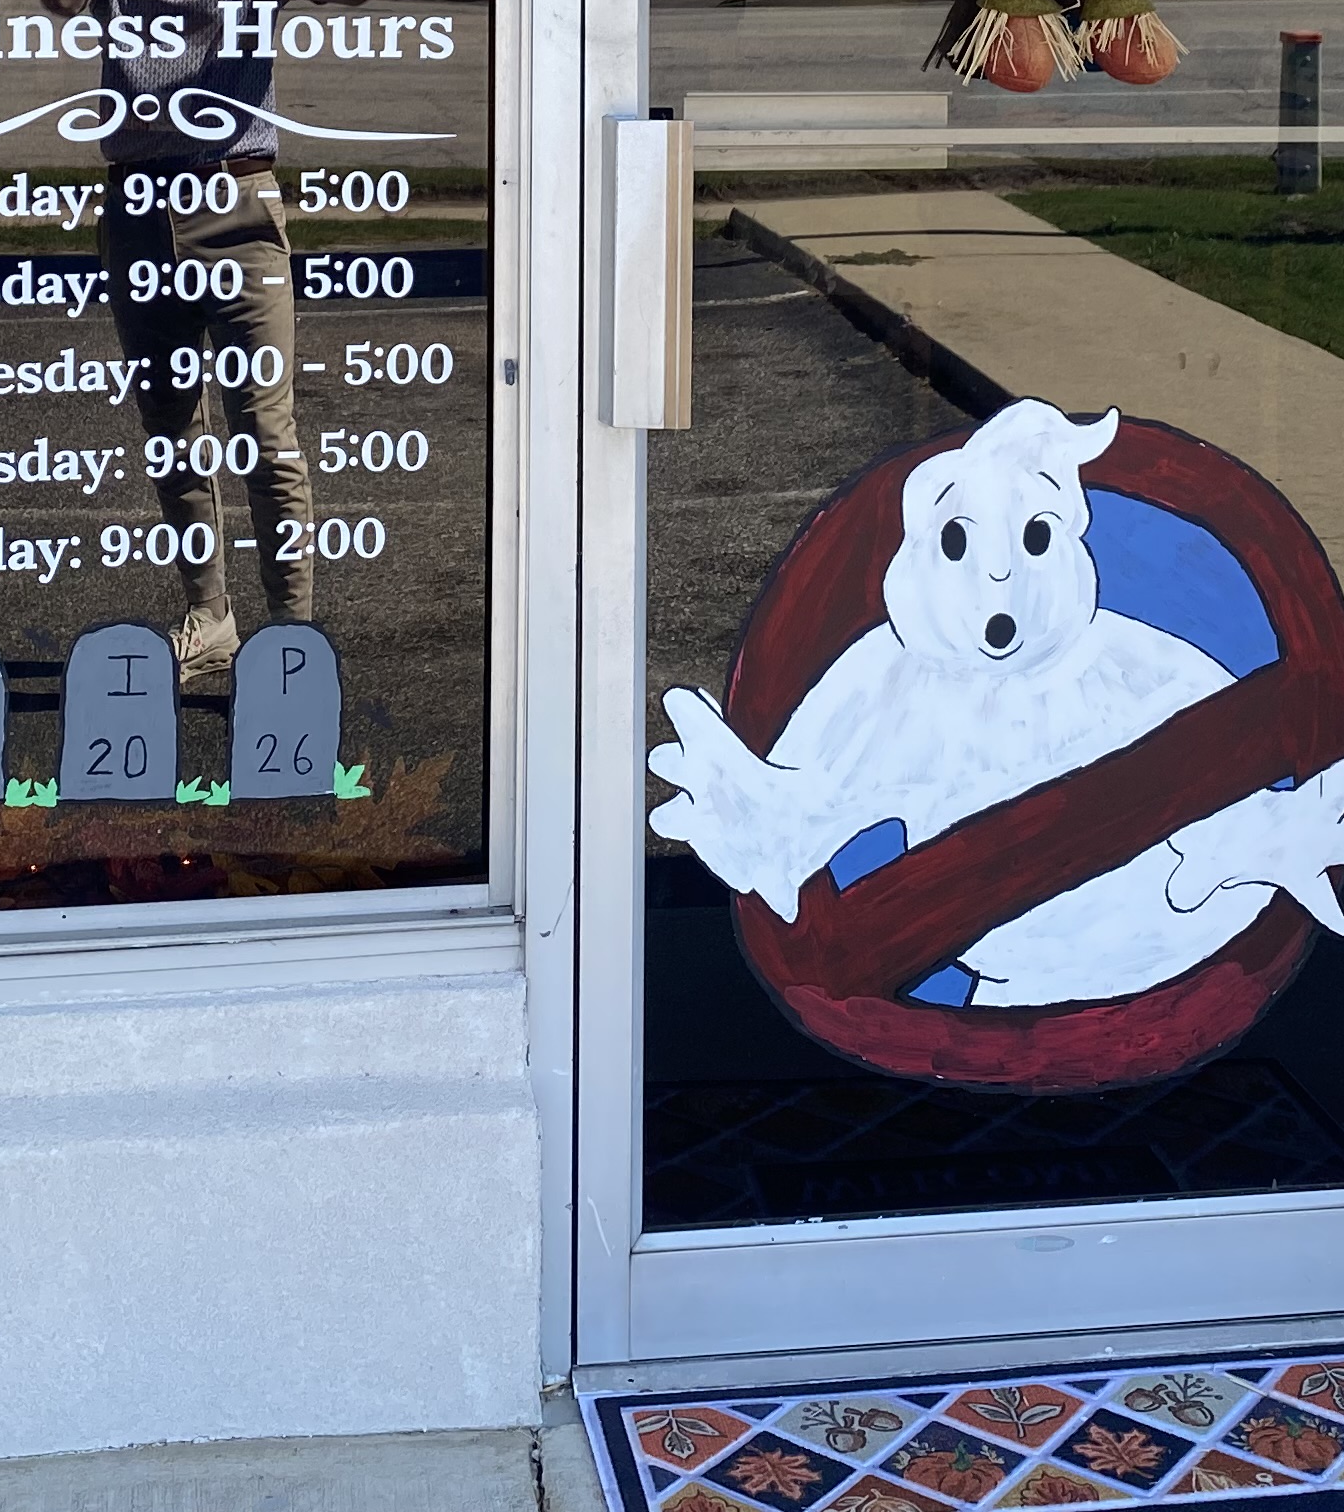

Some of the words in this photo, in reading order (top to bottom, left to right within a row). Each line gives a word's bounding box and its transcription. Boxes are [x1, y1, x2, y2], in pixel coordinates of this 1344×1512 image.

[217, 0, 454, 60] Hours
[123, 172, 239, 215] 9:00
[299, 168, 409, 213] 5:00
[128, 258, 243, 302] 9:00
[304, 254, 414, 299] 5:00
[170, 345, 284, 389] 9:00
[344, 340, 453, 386] 5:00
[144, 433, 259, 478] 9:00
[319, 428, 429, 473] 5:00
[100, 522, 215, 567] 9:00
[275, 517, 386, 561] 2:00
[107, 654, 149, 697] I
[281, 647, 306, 695] P
[86, 735, 148, 779] 20
[255, 733, 313, 776] 26
